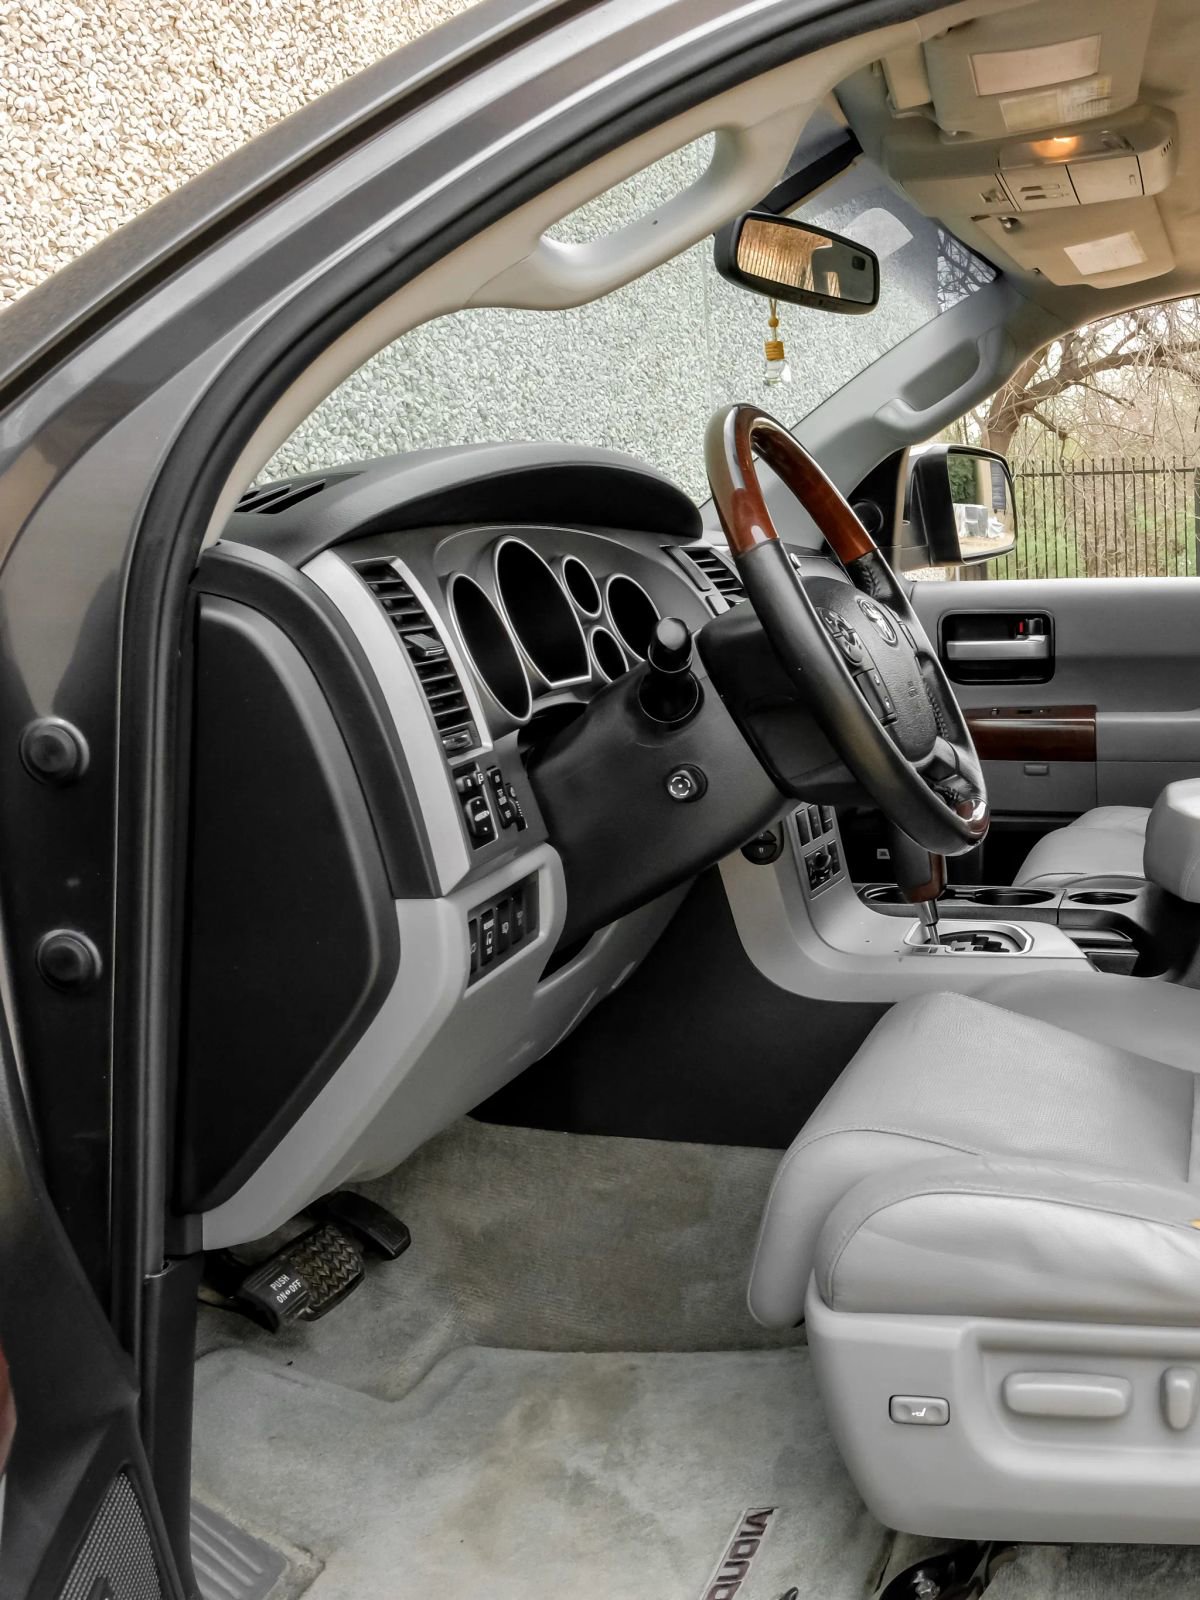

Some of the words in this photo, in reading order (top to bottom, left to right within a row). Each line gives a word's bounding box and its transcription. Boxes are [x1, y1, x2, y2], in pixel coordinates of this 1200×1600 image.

[270, 1274, 290, 1291] PUSH
[276, 1292, 288, 1303] ON
[289, 1279, 301, 1293] OFF
